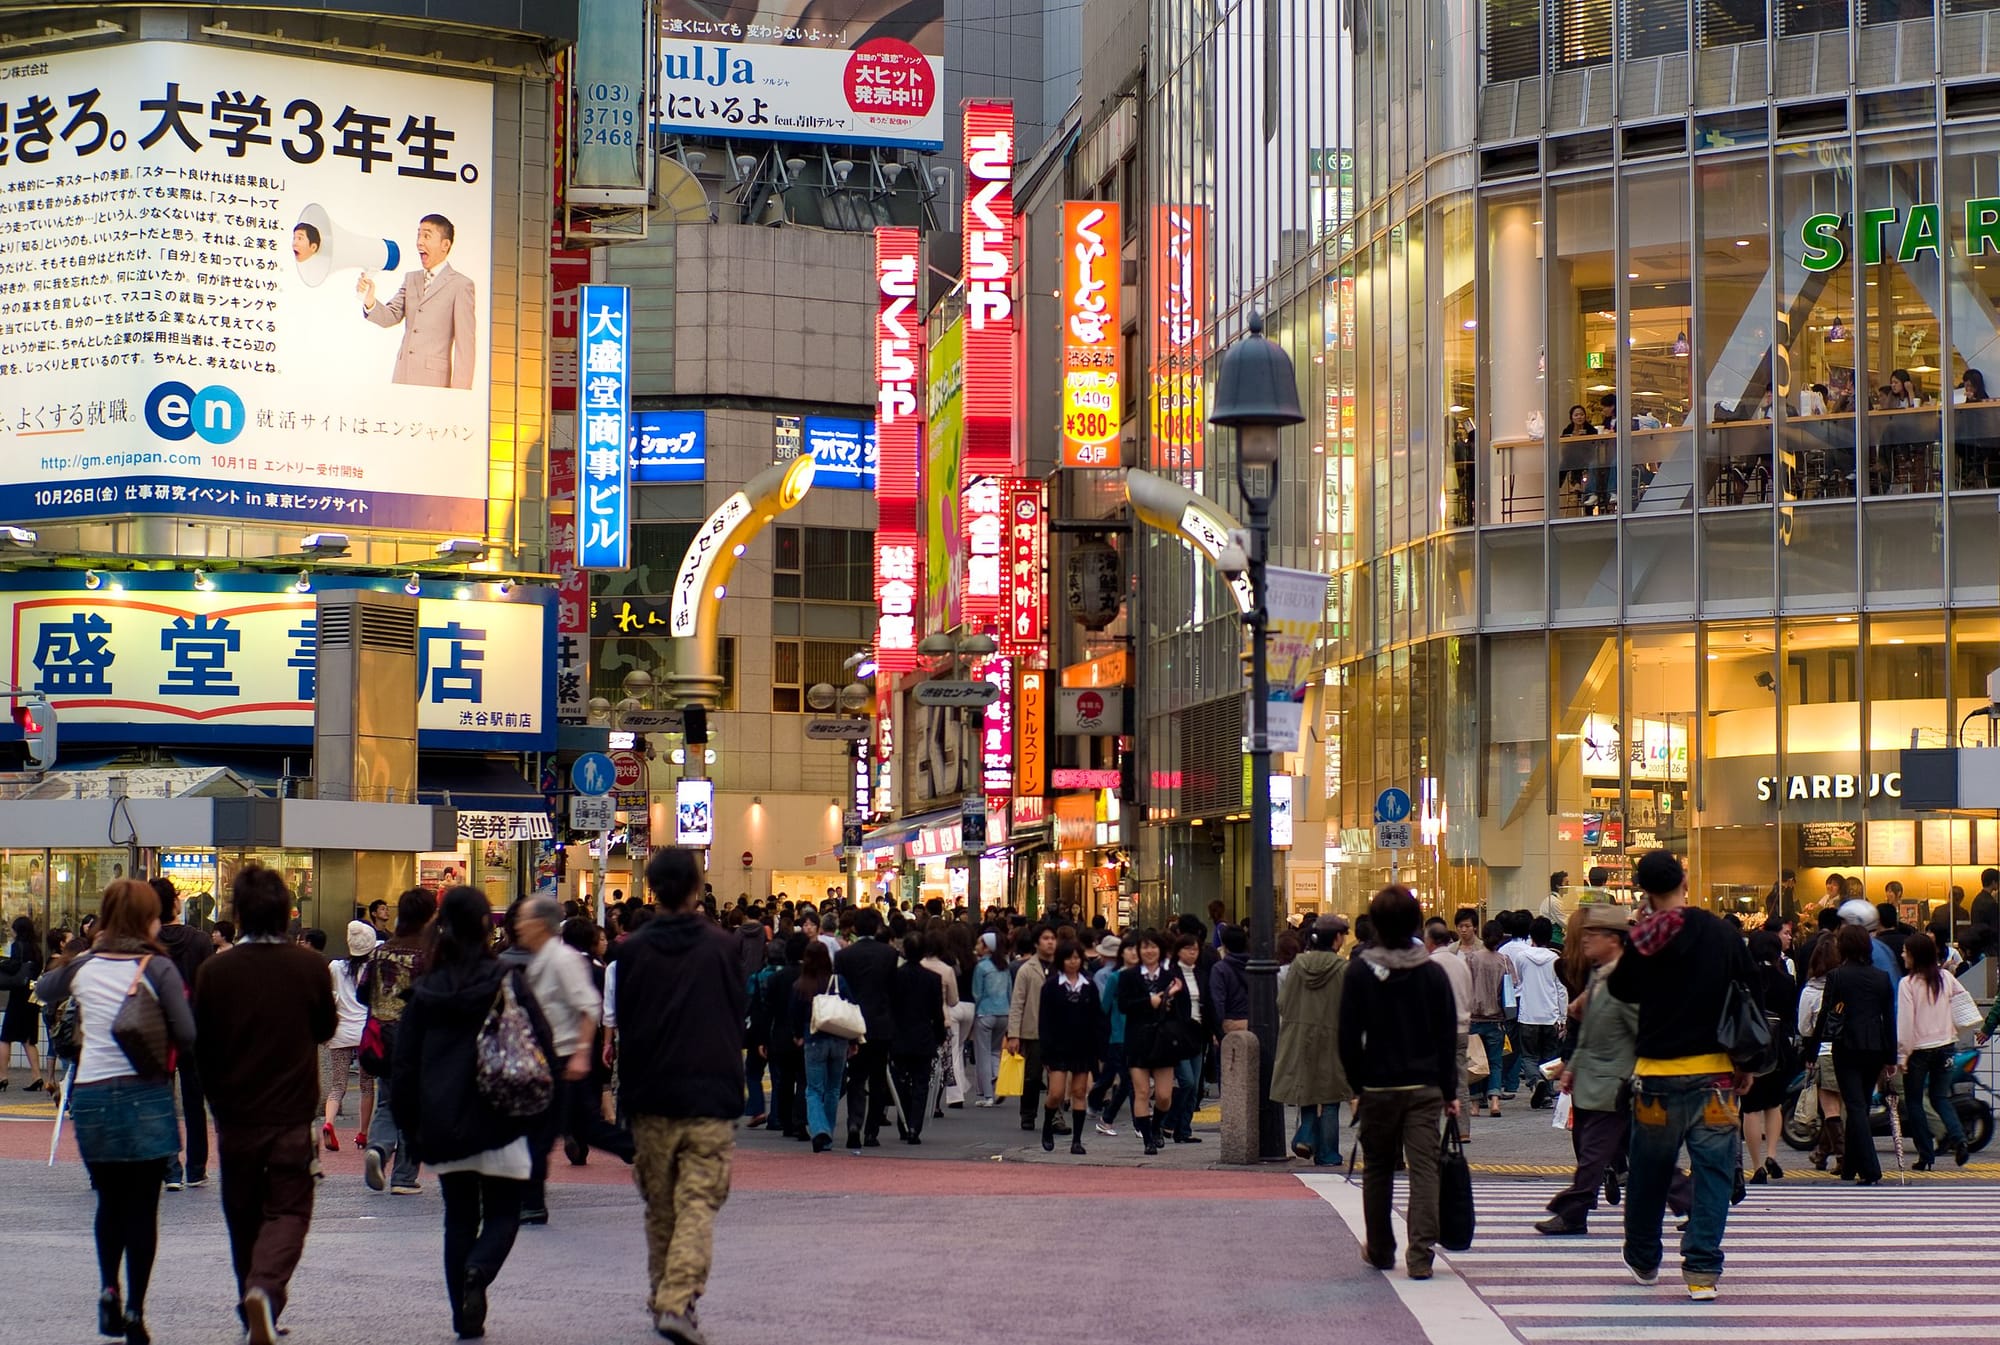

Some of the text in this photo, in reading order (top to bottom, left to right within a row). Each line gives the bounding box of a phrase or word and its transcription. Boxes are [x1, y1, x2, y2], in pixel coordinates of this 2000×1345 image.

[660, 46, 754, 87] ulJa
[856, 65, 922, 86] 大ヒット
[588, 83, 629, 102] (03)
[855, 85, 923, 107] 発売中!!
[583, 108, 633, 126] 3719
[583, 129, 632, 146] 2468
[0, 166, 285, 194] 、本格的に一斉スタートの季節。「スタート良ければ結果良し」
[967, 131, 1011, 329] さくらや
[879, 255, 917, 423] さくらや
[1068, 352, 1115, 367] 渋谷名物
[1068, 373, 1117, 388] ハンバーグ
[1073, 391, 1111, 409] 140g
[157, 394, 232, 430] en
[256, 408, 475, 441] 就活サイトはエンジャパン
[586, 305, 622, 548] 大盛堂商事ビル
[776, 436, 800, 459] 0120 966
[1077, 446, 1106, 463] 4F
[41, 452, 201, 470] http://gm.enjapan.com
[211, 456, 364, 479] 10月1日 エントリー受付開始
[35, 484, 369, 514] 10月26日(金) 仕事研究イベント in 東京ビッグサイト
[459, 711, 532, 728] 渋谷駅前店
[623, 716, 683, 726] 渋谷センター
[1025, 693, 1038, 793] リトルスプーン
[1650, 746, 1686, 760] LOVE
[1635, 832, 1656, 840] MOVIE
